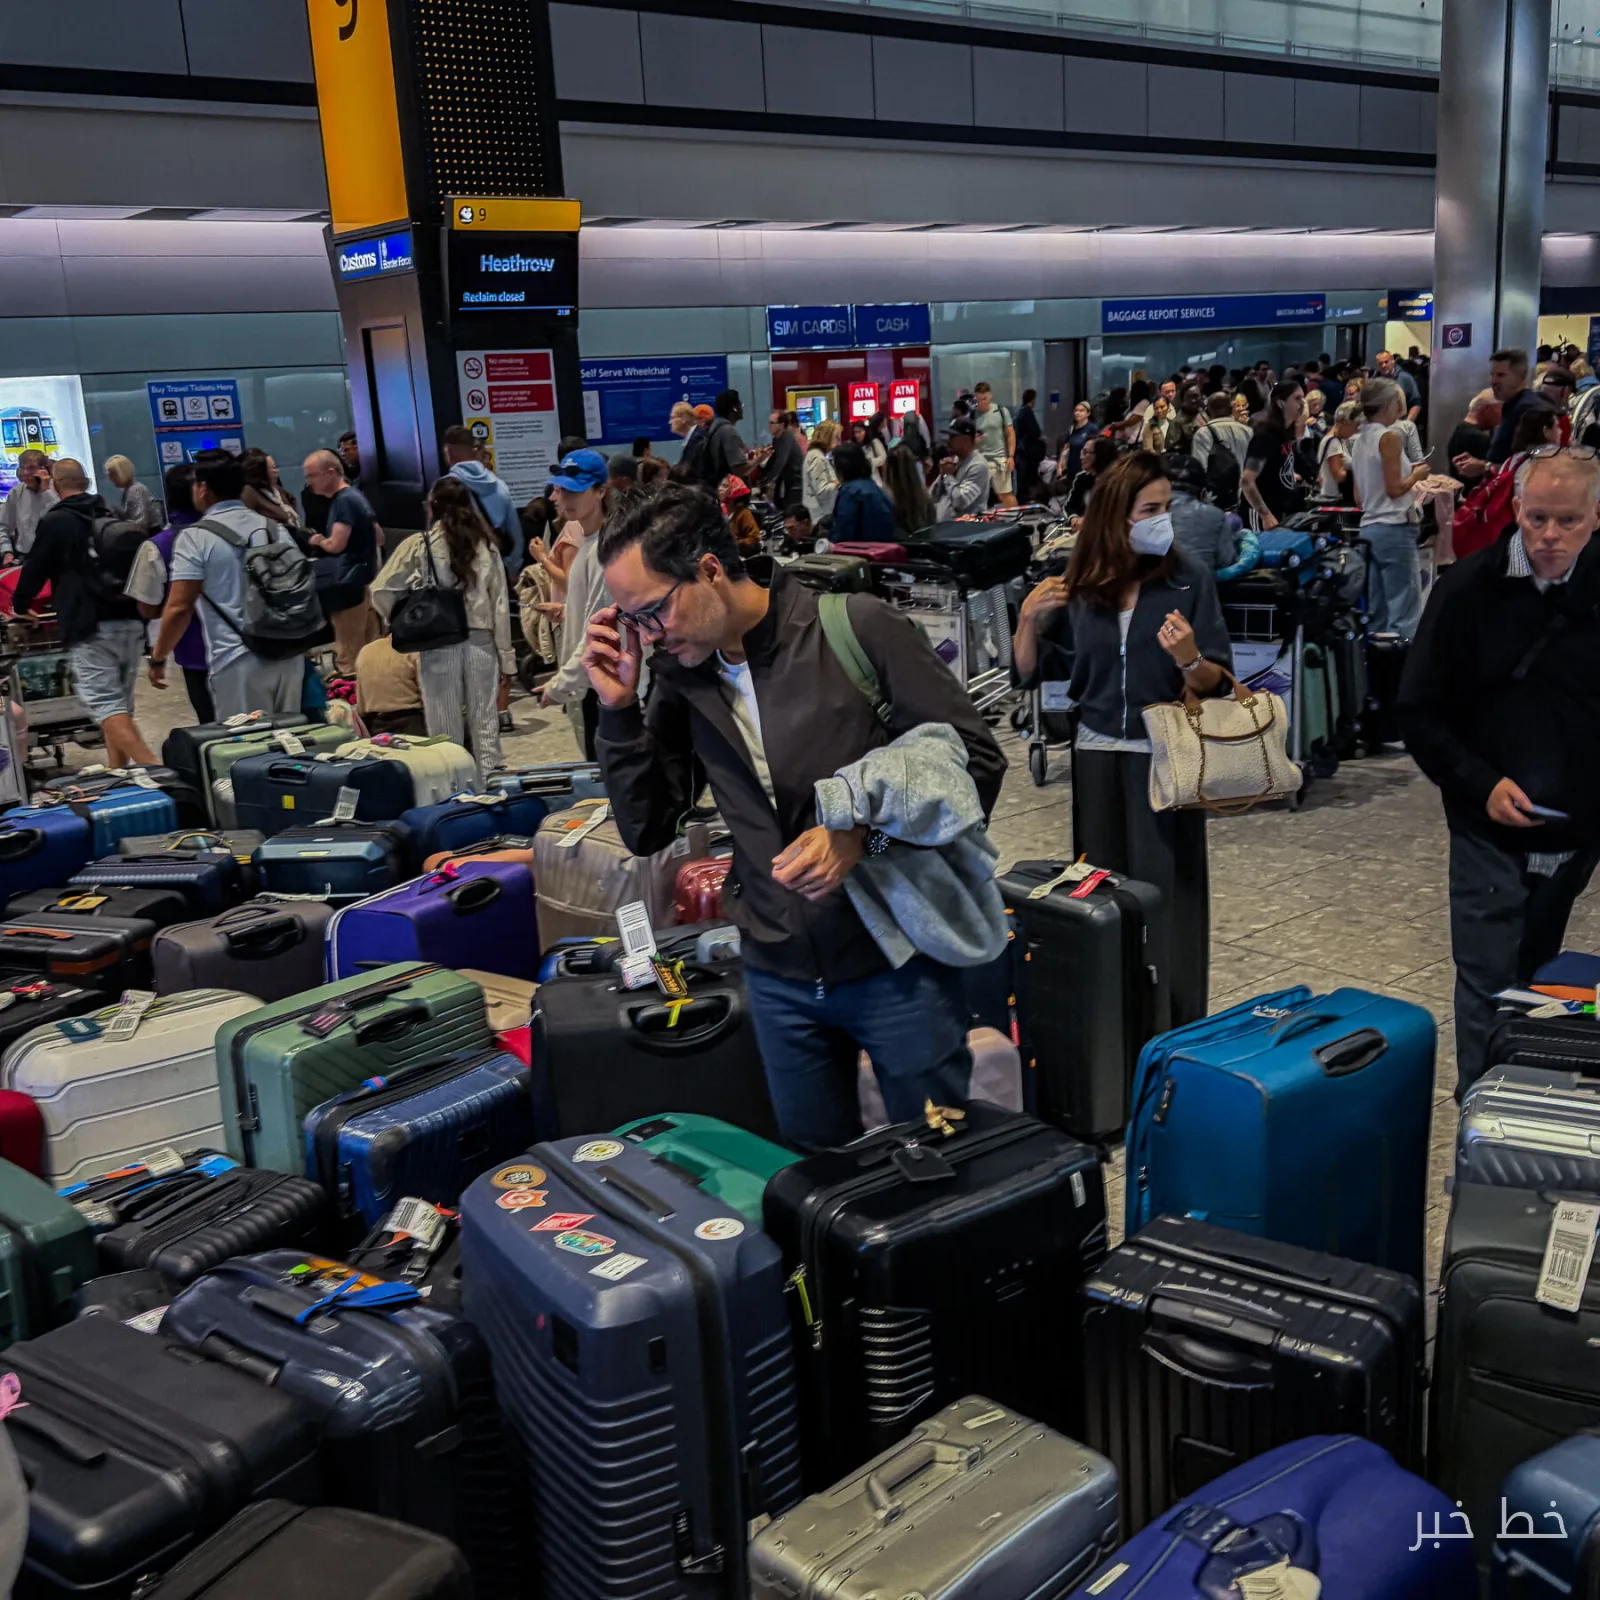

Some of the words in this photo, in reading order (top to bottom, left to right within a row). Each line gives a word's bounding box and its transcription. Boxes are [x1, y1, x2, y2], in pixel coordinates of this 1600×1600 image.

[478, 207, 487, 221] 9
[340, 252, 377, 272] Customs
[480, 253, 555, 272] Heathrow
[463, 292, 497, 302] Reclaim
[498, 291, 525, 302] closed
[1108, 310, 1147, 322] BAGGAGE
[1148, 308, 1179, 320] REPORT
[1180, 307, 1216, 319] SERVICES
[774, 320, 799, 336] SIM
[802, 319, 847, 335] CARDS
[876, 318, 910, 333] CASH
[580, 368, 597, 379] Self
[598, 368, 623, 378] Serve
[624, 366, 671, 377] Wheelchair
[151, 385, 165, 394] Buy
[166, 384, 189, 393] Travel
[189, 384, 216, 392] Tickets
[217, 383, 234, 391] Here
[854, 387, 874, 398] ATM
[895, 385, 915, 396] ATM
